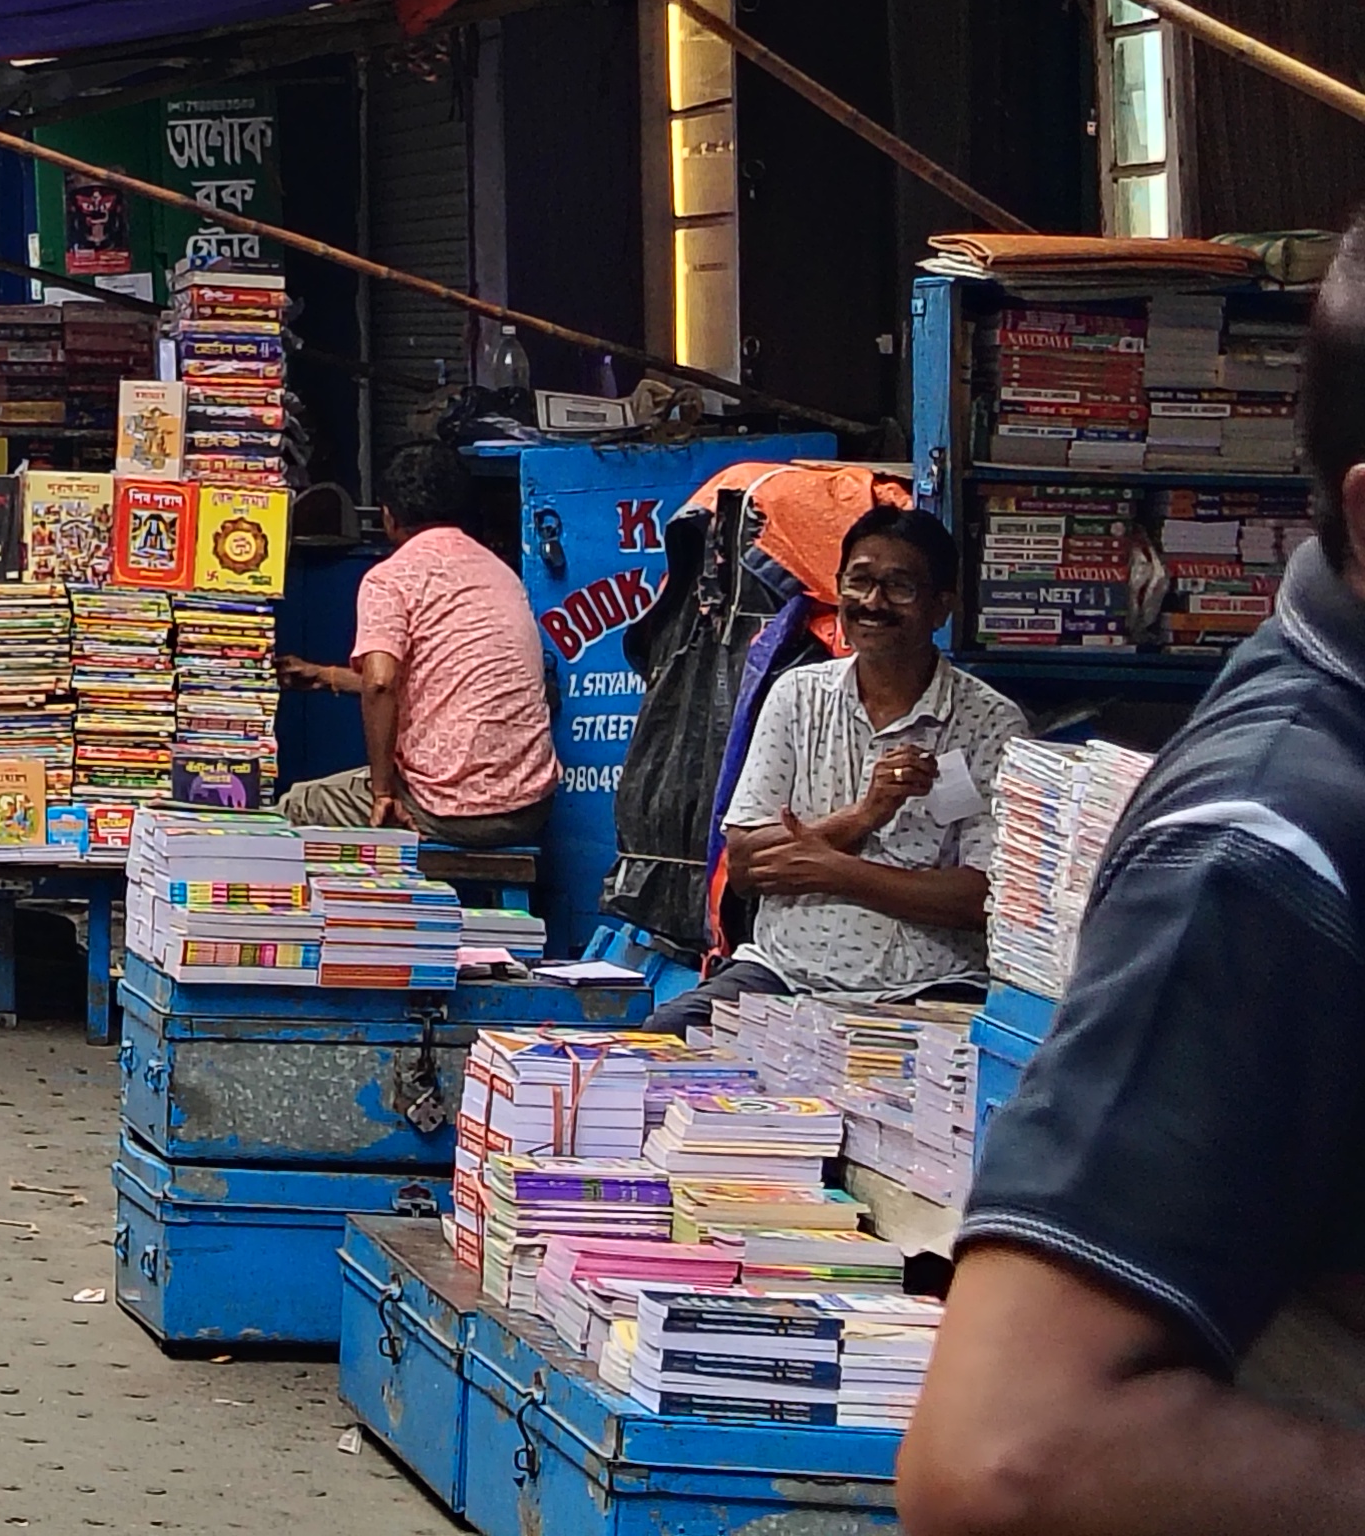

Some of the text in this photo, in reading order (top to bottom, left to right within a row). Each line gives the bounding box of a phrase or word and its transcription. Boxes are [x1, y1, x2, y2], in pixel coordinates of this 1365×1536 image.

[166, 116, 273, 169] অশোক
[127, 487, 184, 510] শিব পুরাণ
[615, 498, 665, 553] K
[539, 566, 656, 664] BOOK
[1039, 587, 1084, 604] NEET
